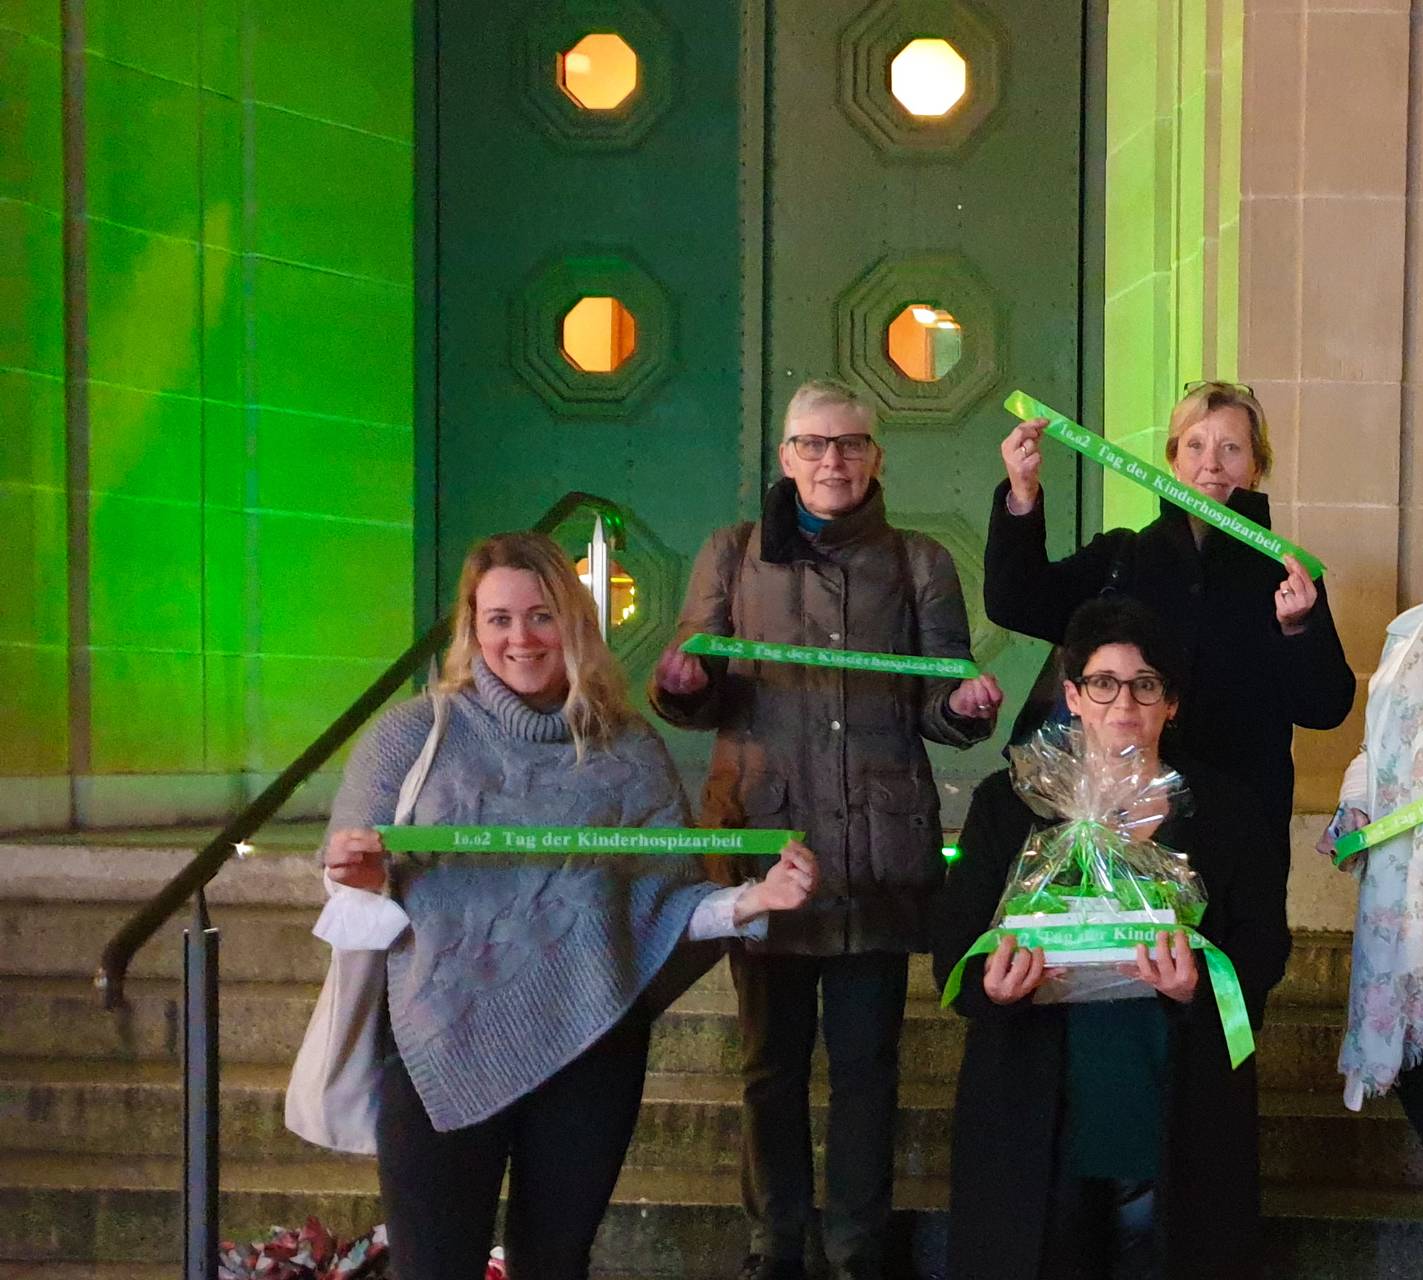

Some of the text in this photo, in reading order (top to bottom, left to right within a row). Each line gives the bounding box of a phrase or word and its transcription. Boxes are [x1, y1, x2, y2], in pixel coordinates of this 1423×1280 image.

[1098, 444, 1124, 470] Tag
[1153, 475, 1282, 553] Kinderhospizarbeit
[502, 831, 537, 849] Tag
[542, 831, 572, 847] der
[577, 831, 743, 851] Kinderhospizarbeit
